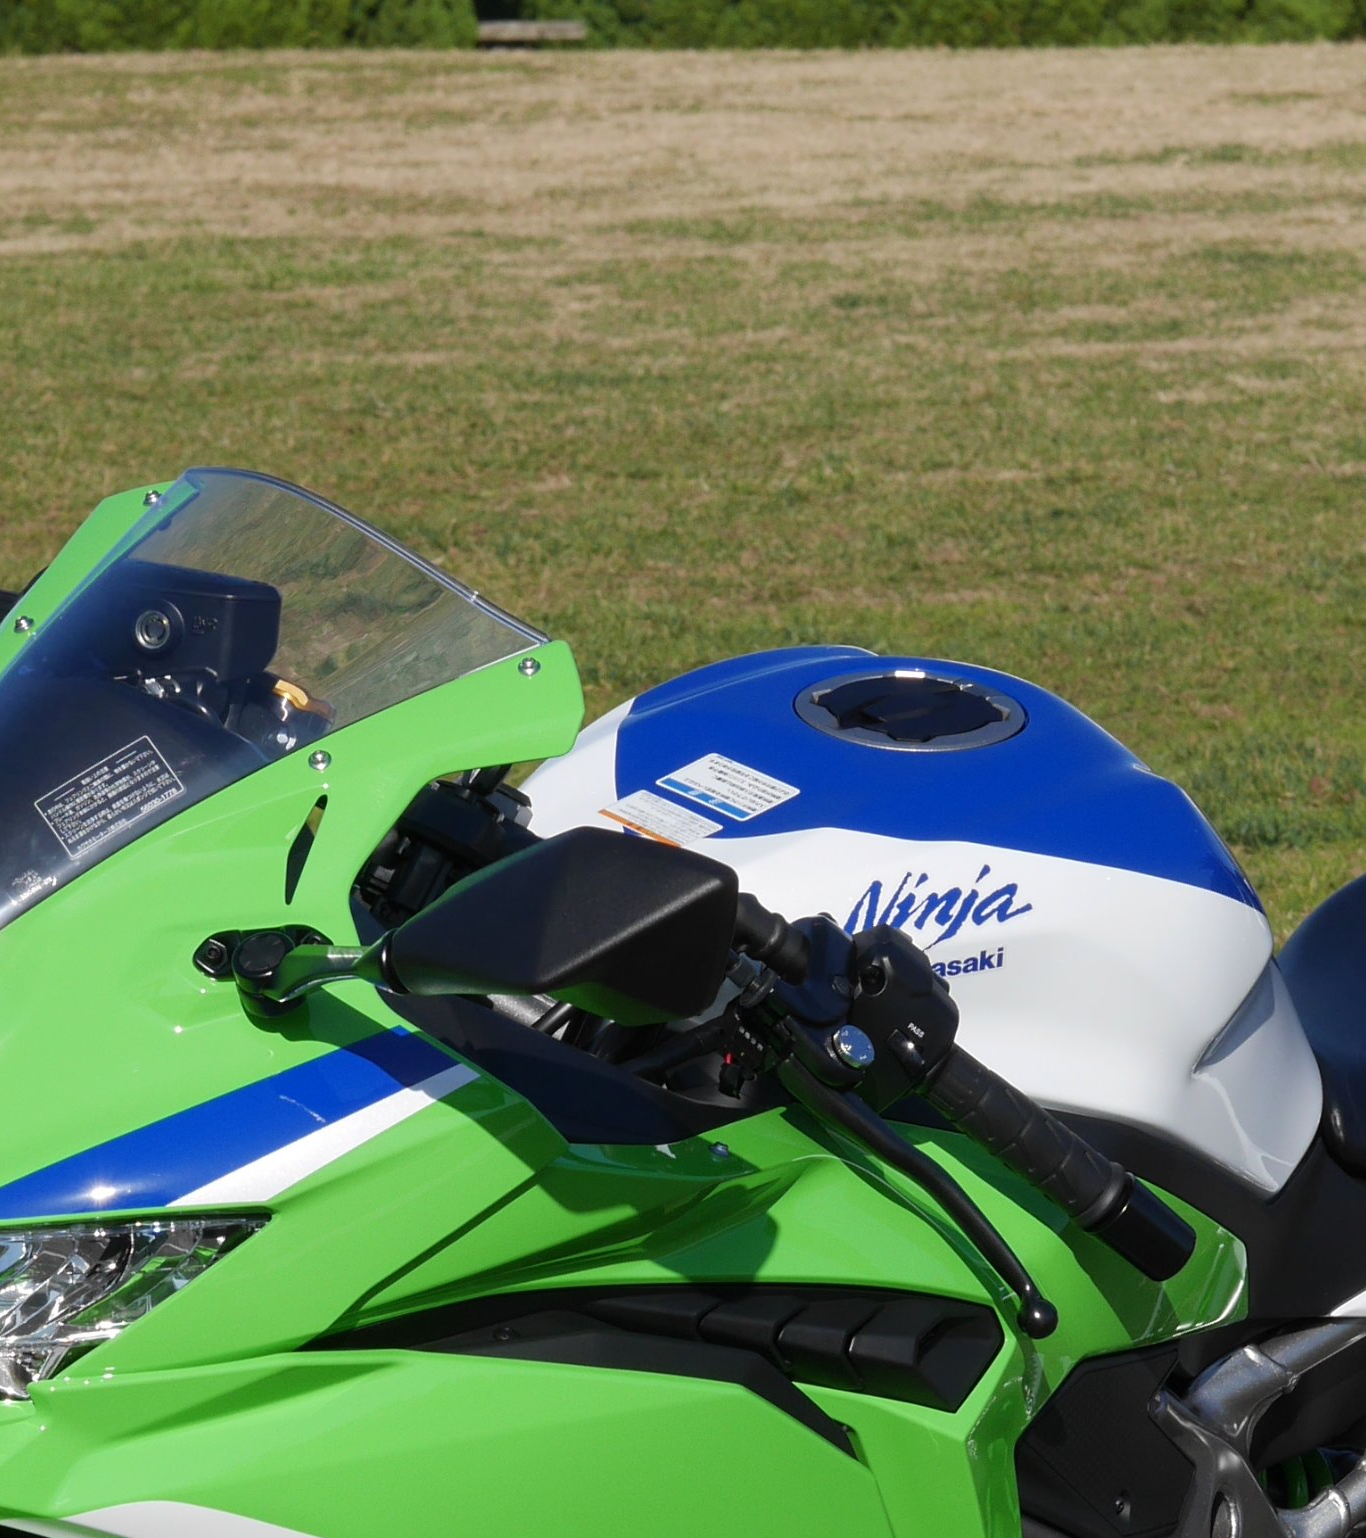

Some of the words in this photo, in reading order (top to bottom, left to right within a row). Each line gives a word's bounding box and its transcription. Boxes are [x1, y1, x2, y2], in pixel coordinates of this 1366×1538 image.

[843, 864, 1033, 953] Ninja
[931, 947, 1004, 977] asaki
[907, 1021, 925, 1039] PASS
